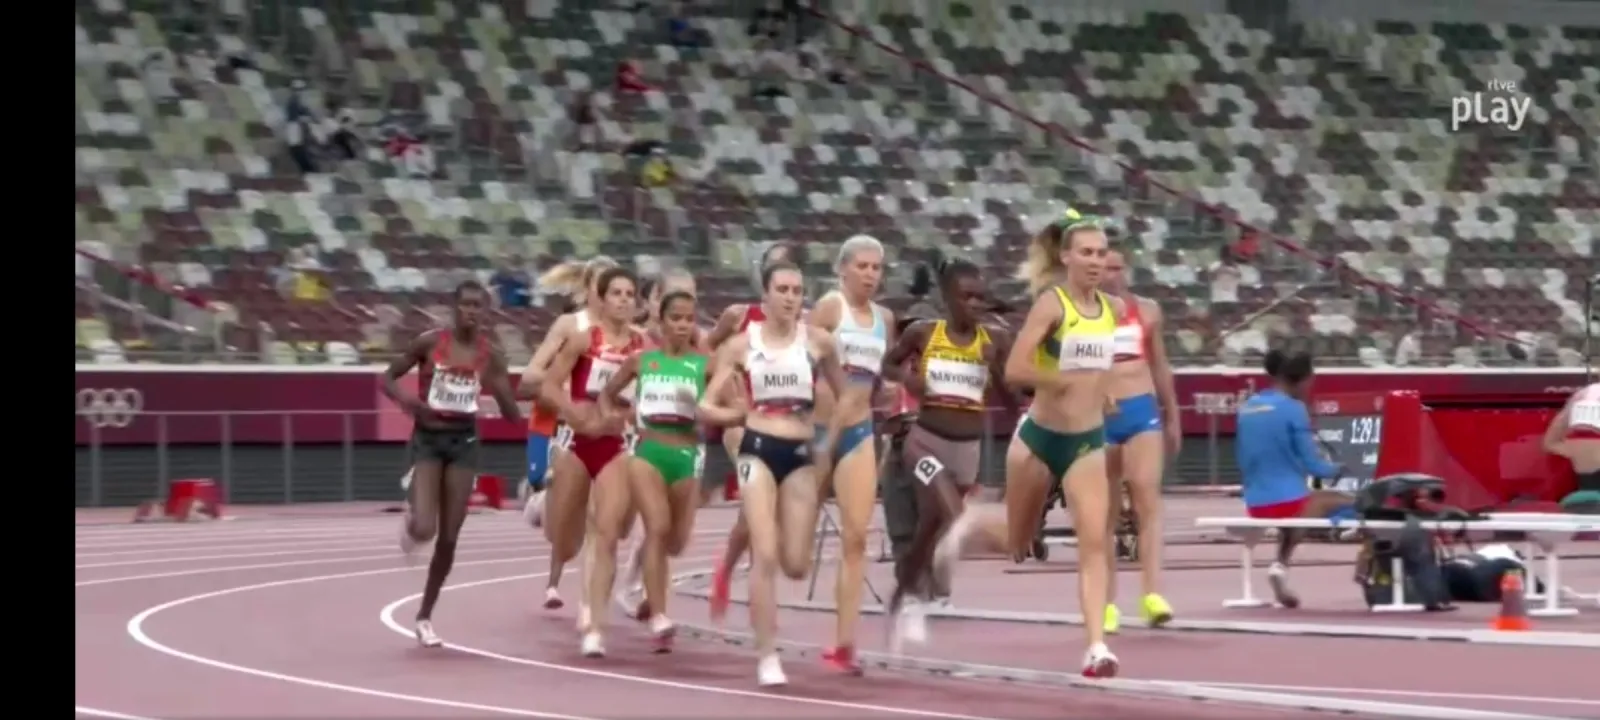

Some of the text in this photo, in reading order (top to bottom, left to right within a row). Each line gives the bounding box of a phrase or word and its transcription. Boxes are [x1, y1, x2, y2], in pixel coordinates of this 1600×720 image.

[1075, 343, 1104, 359] HALL
[764, 373, 798, 388] MUIR
[919, 459, 937, 478] 8
